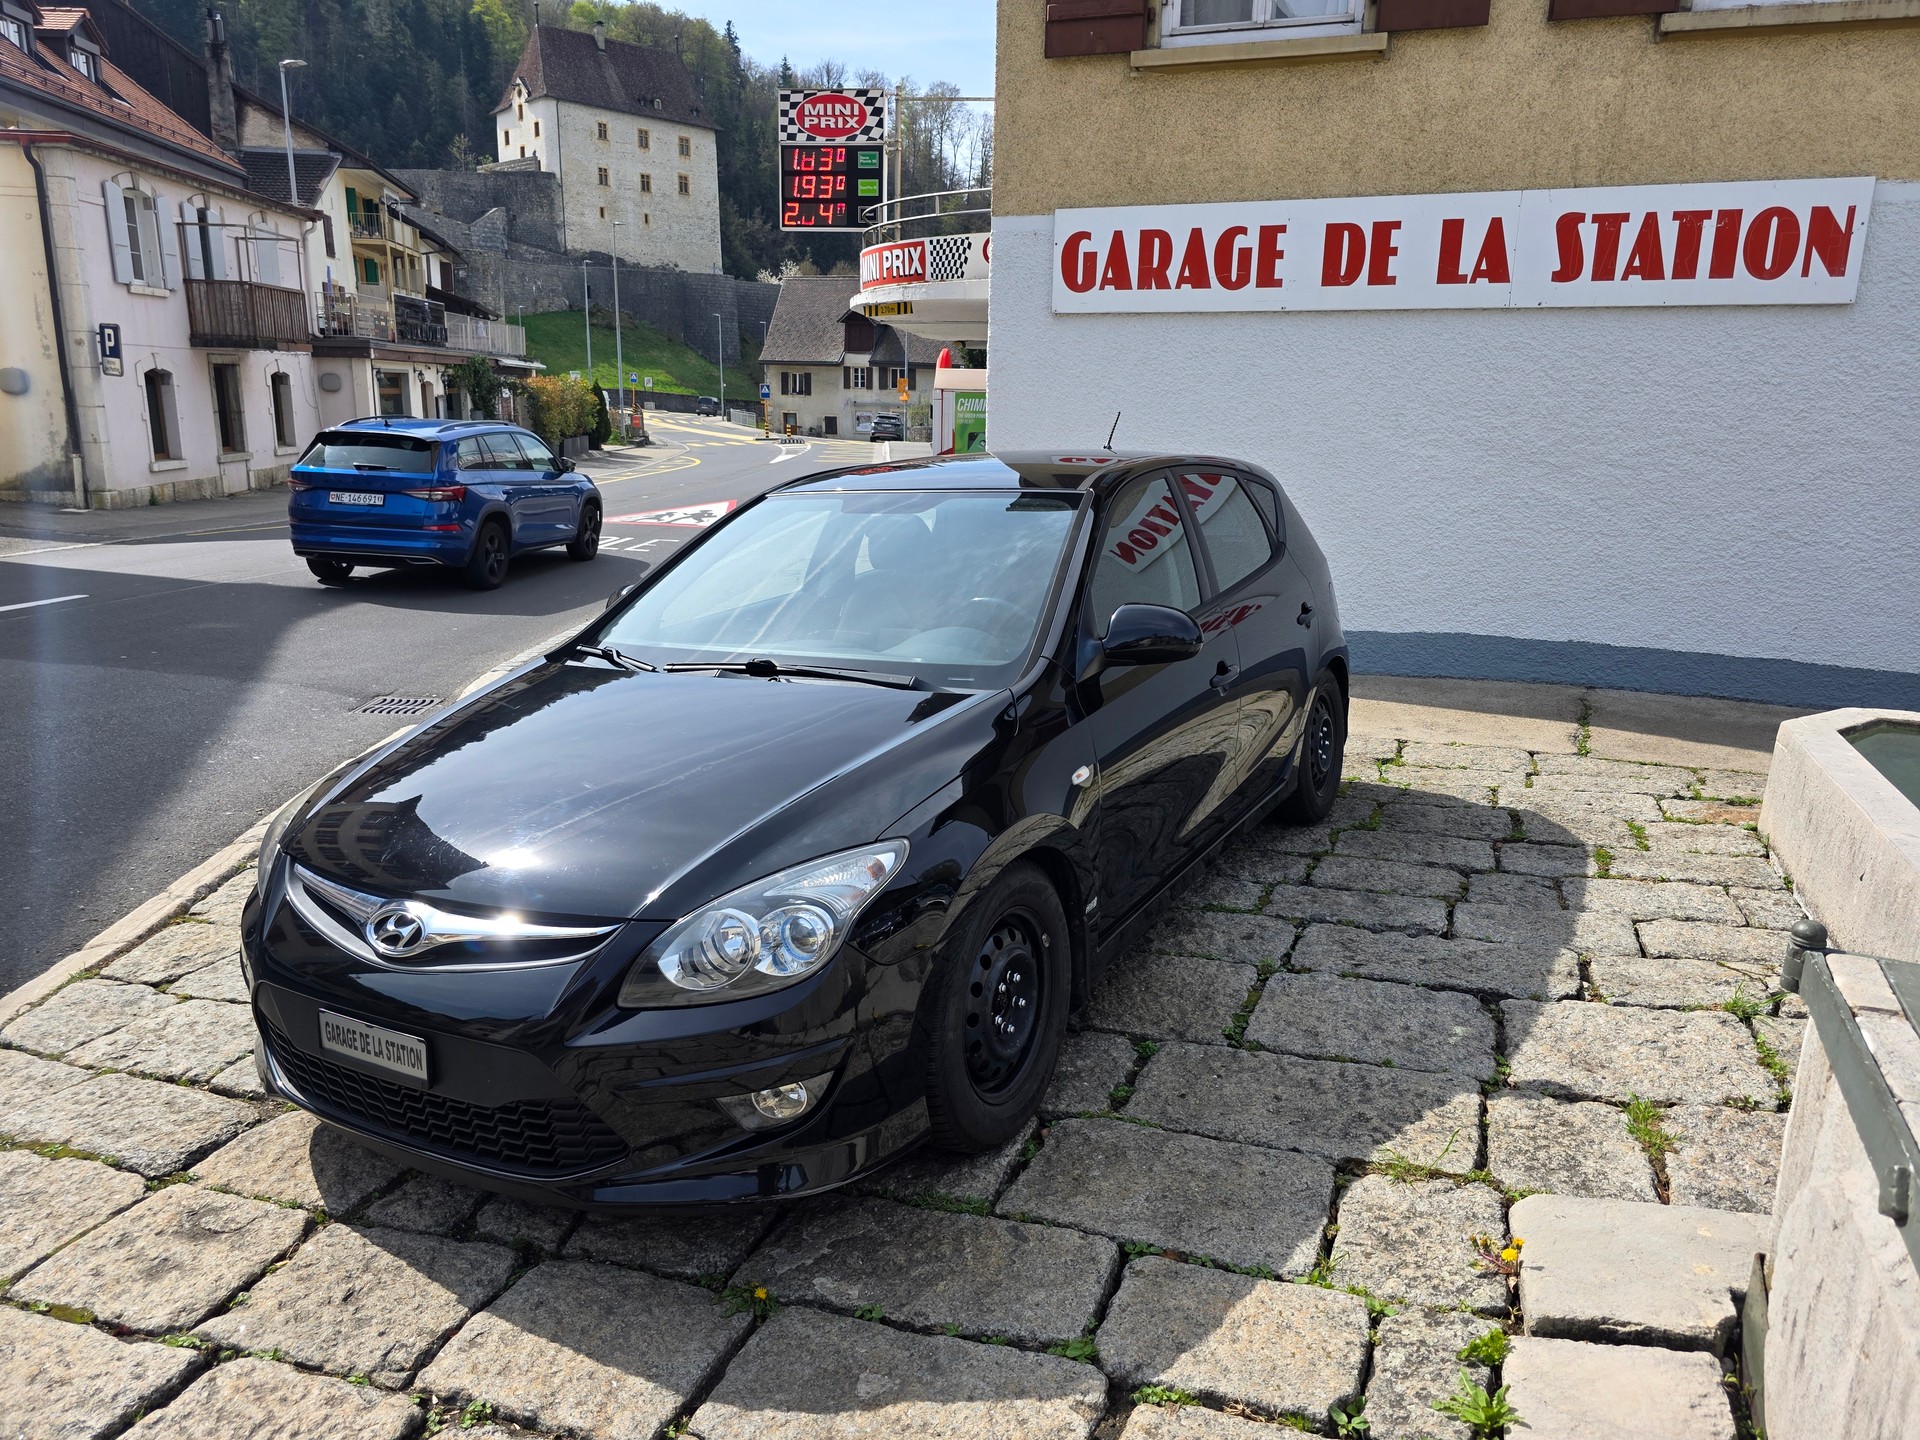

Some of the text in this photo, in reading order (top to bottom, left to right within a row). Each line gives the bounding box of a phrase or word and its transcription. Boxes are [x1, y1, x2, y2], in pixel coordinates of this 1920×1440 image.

[804, 103, 860, 116] MINI
[804, 116, 860, 129] PRIX
[862, 245, 923, 283] MINI PRIX
[1060, 204, 1857, 294] GARAGE DE LA STATION
[104, 328, 115, 355] P
[325, 1021, 423, 1072] GARAGE DE LA STATION
